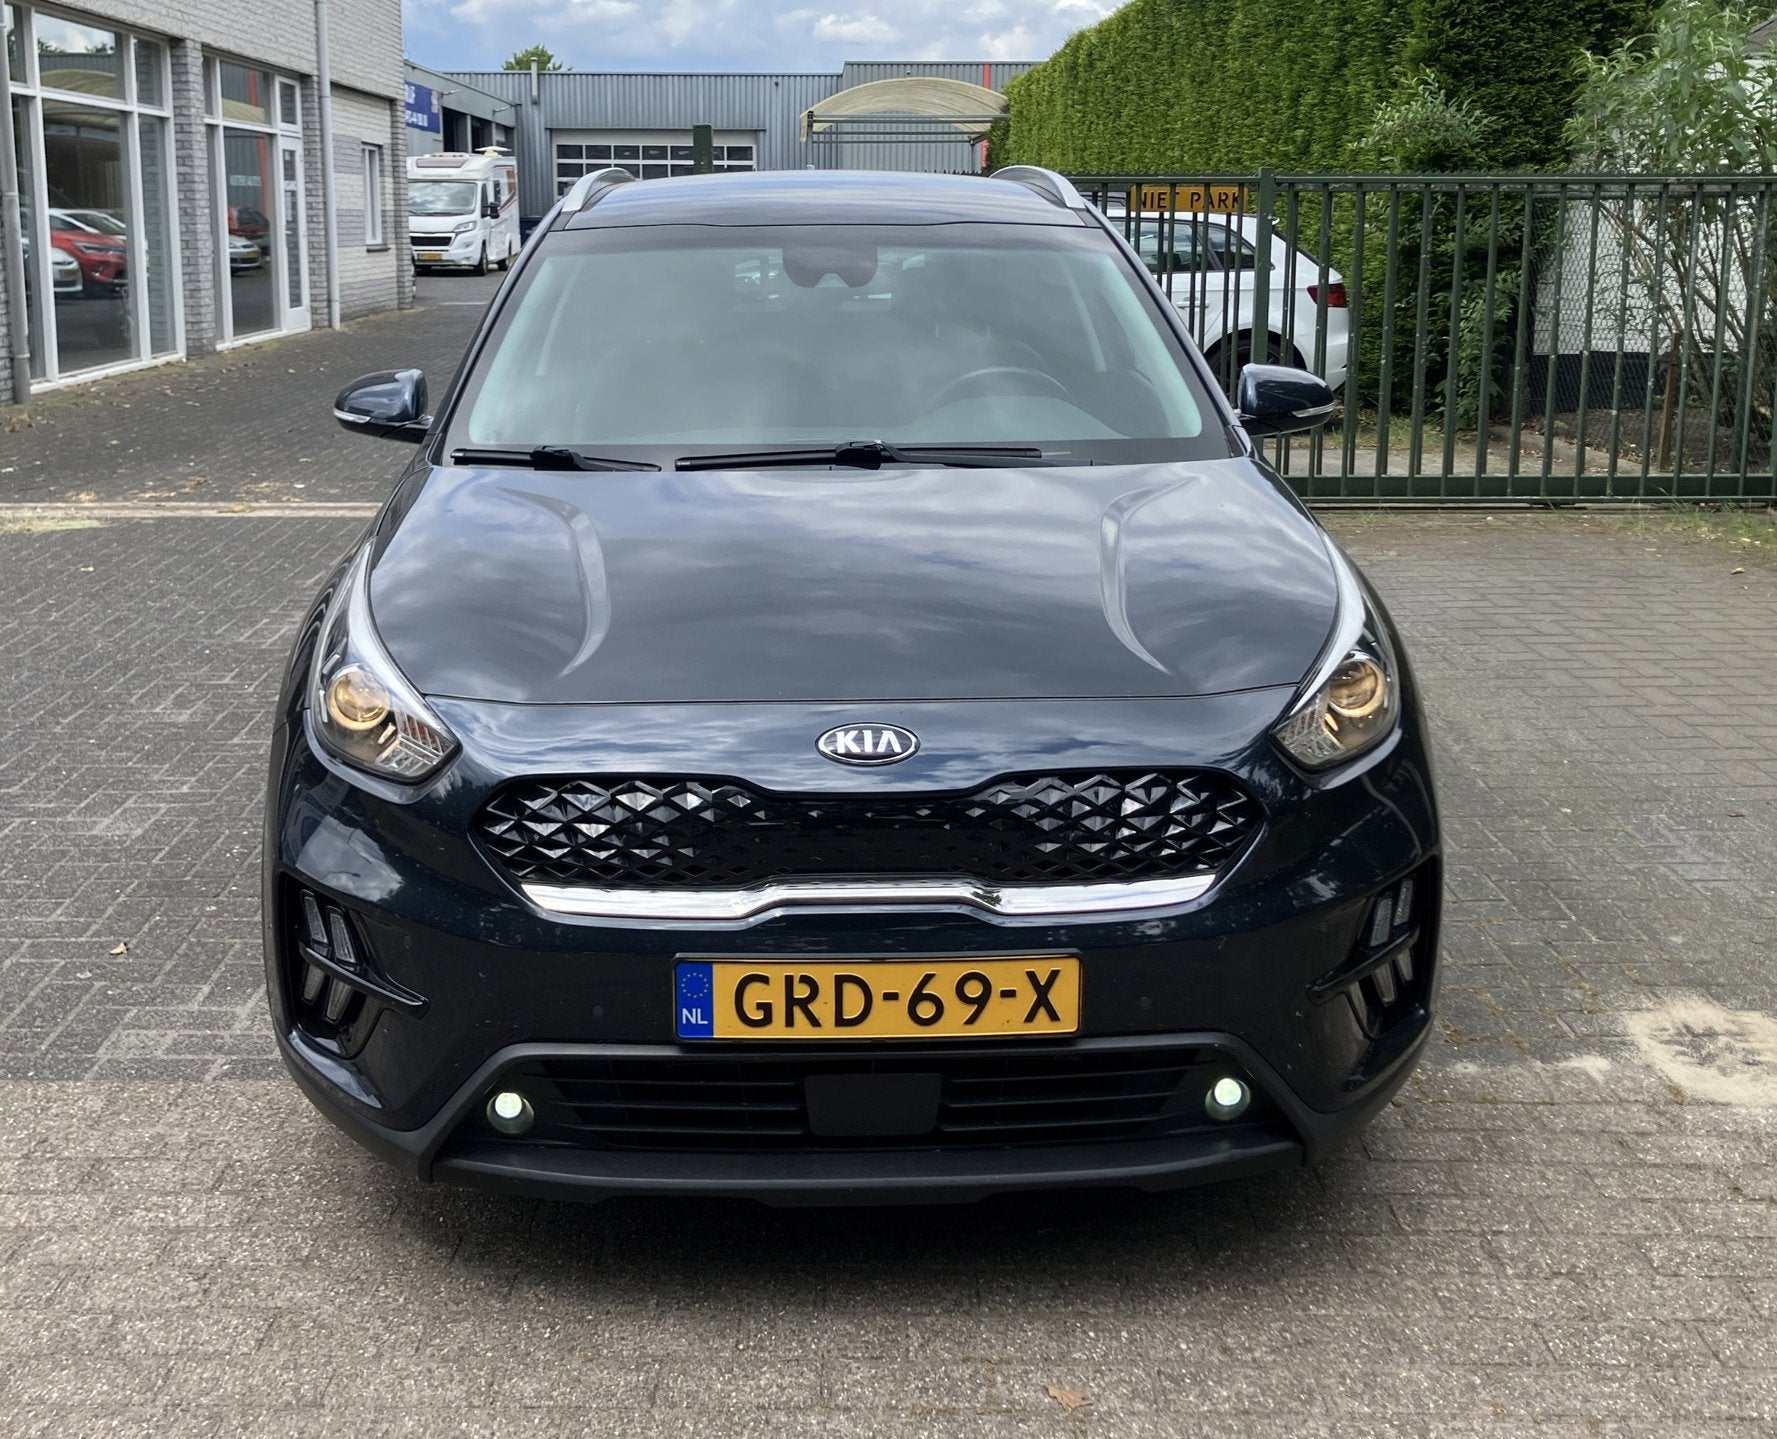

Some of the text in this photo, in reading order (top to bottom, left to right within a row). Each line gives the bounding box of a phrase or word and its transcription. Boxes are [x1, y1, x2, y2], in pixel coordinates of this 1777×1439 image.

[1140, 191, 1180, 208] NIE
[835, 729, 903, 753] KIA
[733, 968, 1062, 1028] GRD-69-X
[682, 1007, 708, 1024] NL
